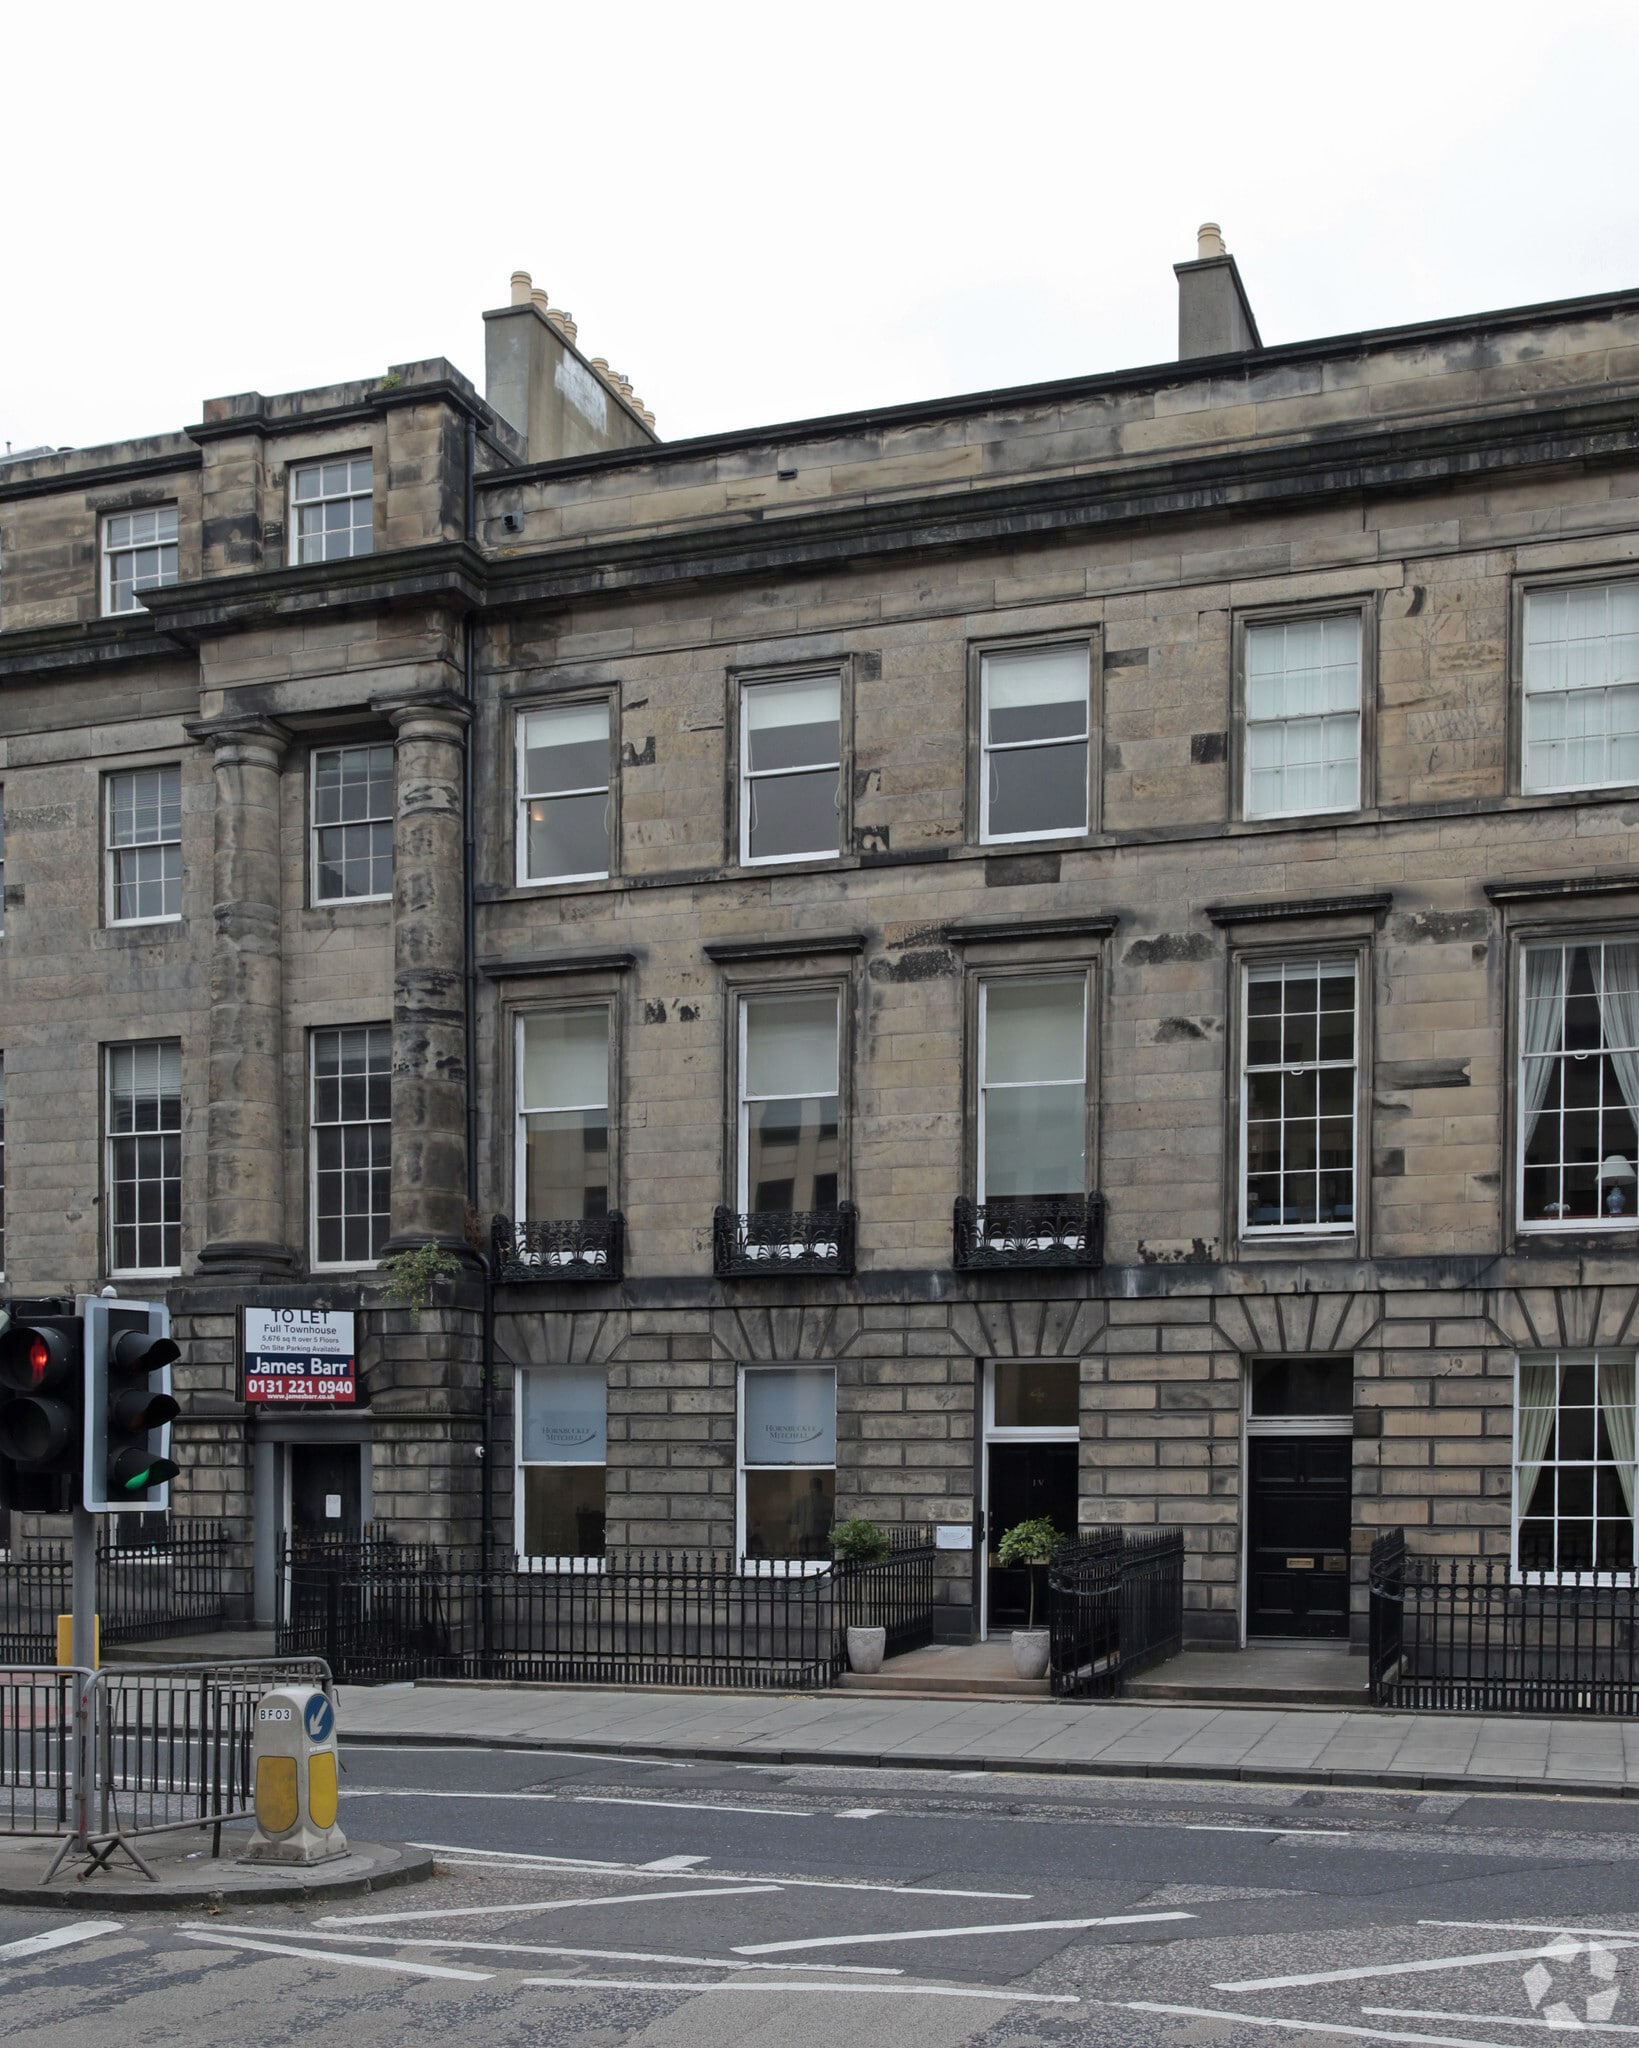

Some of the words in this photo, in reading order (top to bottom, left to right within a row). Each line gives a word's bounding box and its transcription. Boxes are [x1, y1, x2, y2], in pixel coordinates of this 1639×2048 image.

[271, 1309, 294, 1323] TO
[300, 1310, 330, 1324] LET
[264, 1324, 281, 1333] Full
[284, 1325, 337, 1335] Townhouse
[286, 1345, 311, 1353] Parking
[312, 1345, 340, 1353] Available
[250, 1356, 305, 1374] James
[310, 1358, 347, 1375] Barr
[248, 1379, 283, 1393] 0131
[288, 1380, 313, 1393] 221
[318, 1381, 353, 1394] 0940
